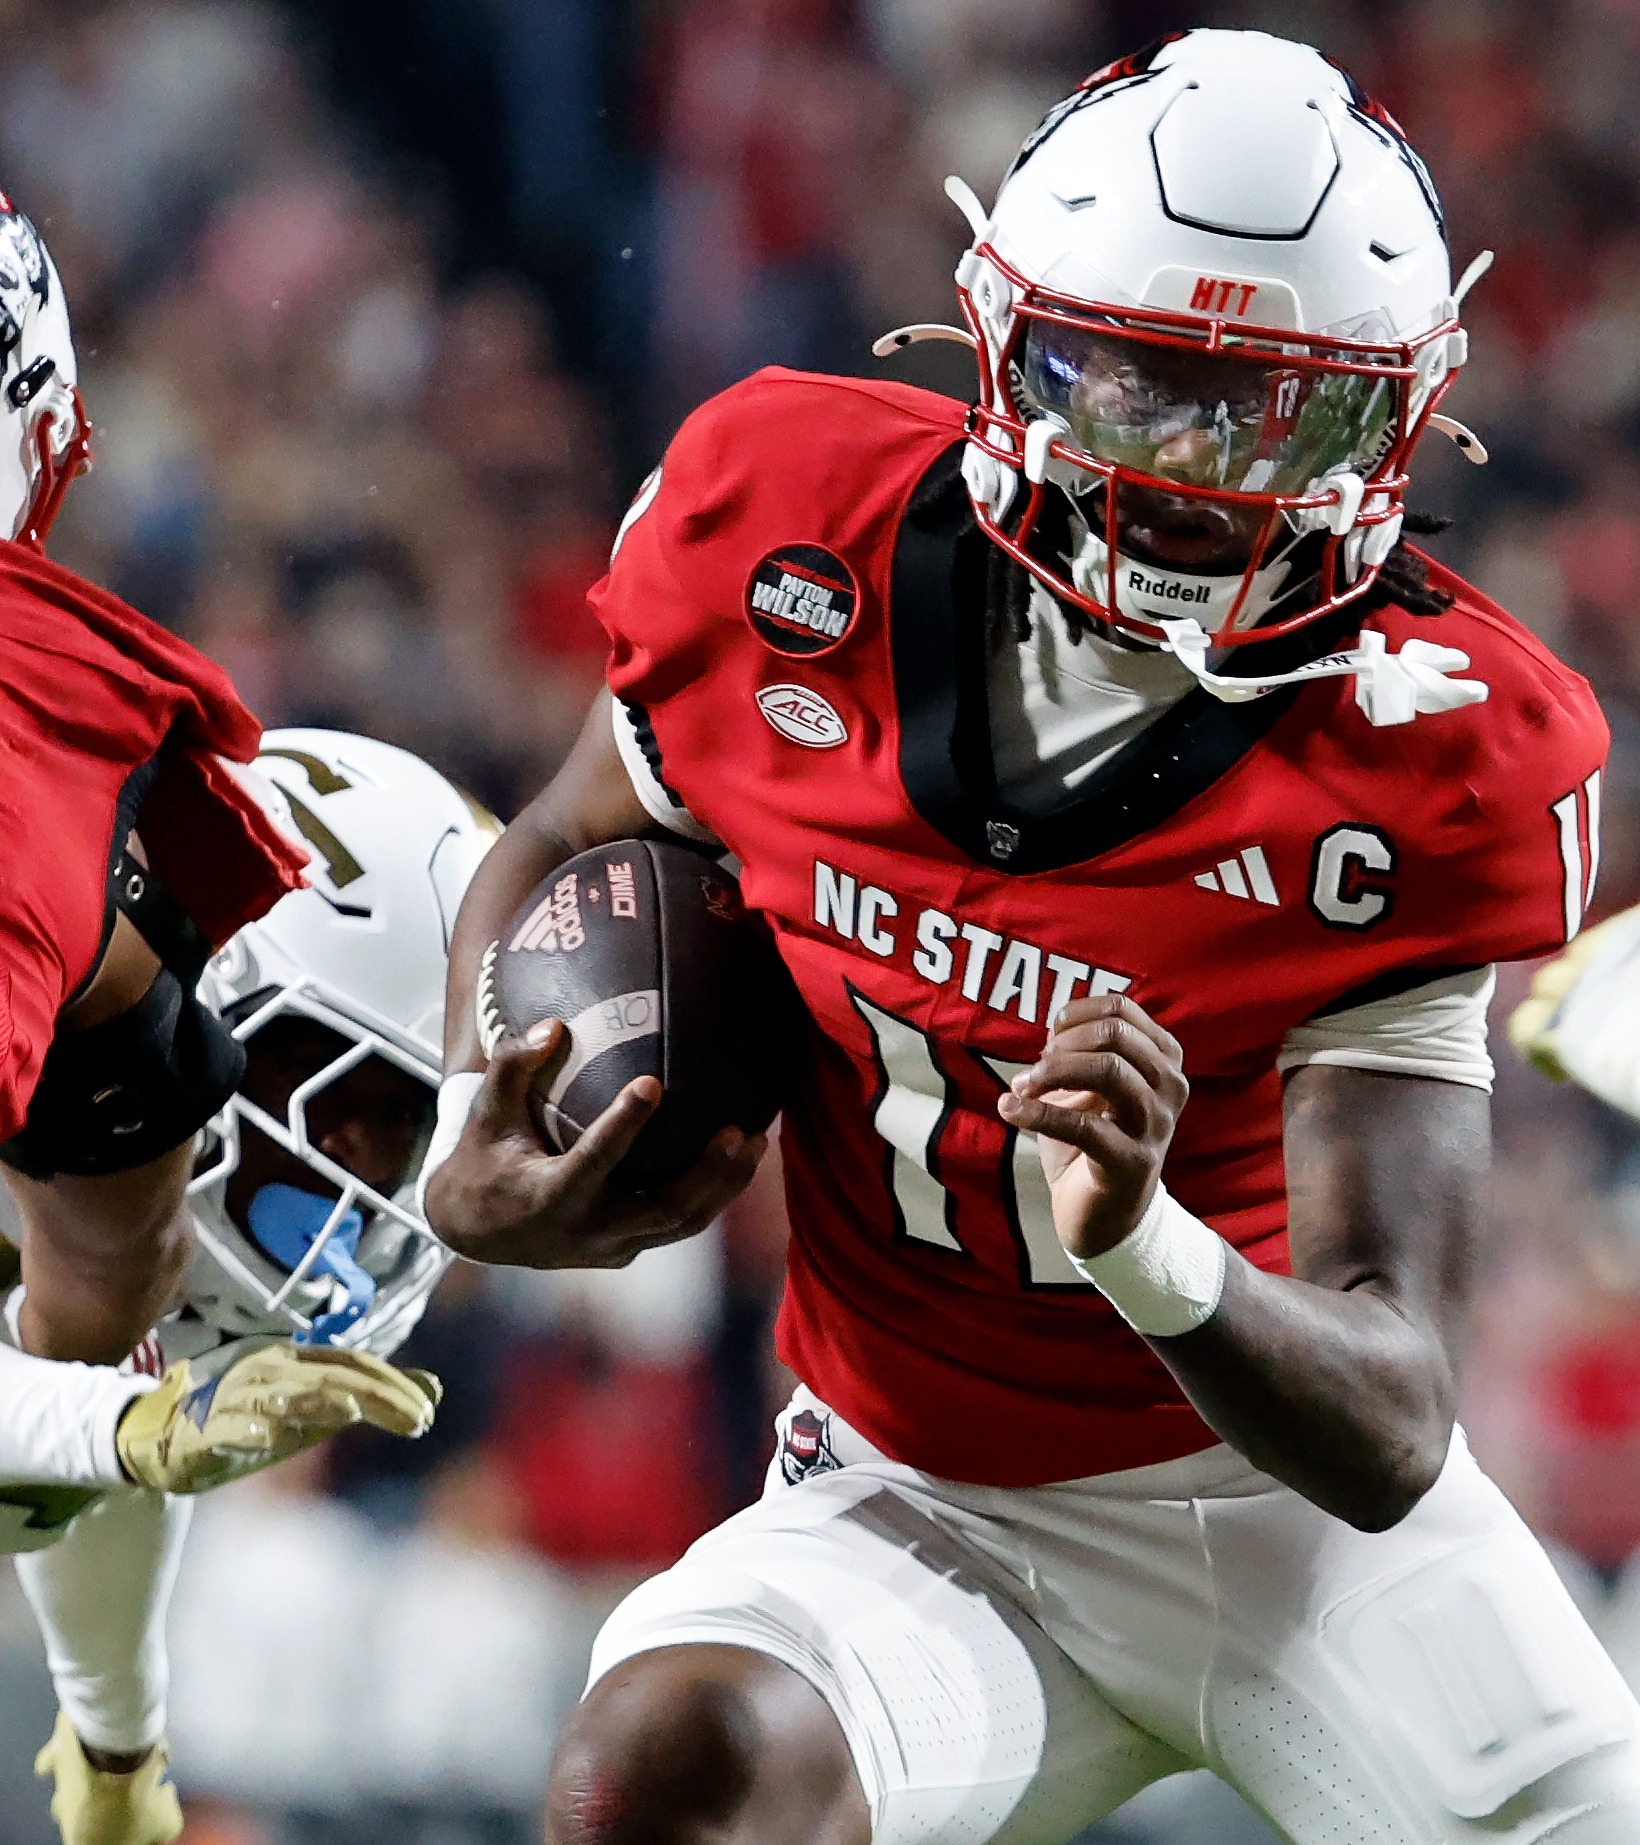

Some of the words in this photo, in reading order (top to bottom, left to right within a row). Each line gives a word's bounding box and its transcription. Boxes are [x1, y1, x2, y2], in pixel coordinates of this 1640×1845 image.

[752, 581, 849, 638] WILSON
[1128, 570, 1211, 604] Riddell
[772, 700, 834, 733] ACC
[605, 860, 637, 919] DIME
[1313, 828, 1391, 925] C
[554, 873, 587, 951] adidas
[814, 860, 898, 957] NC
